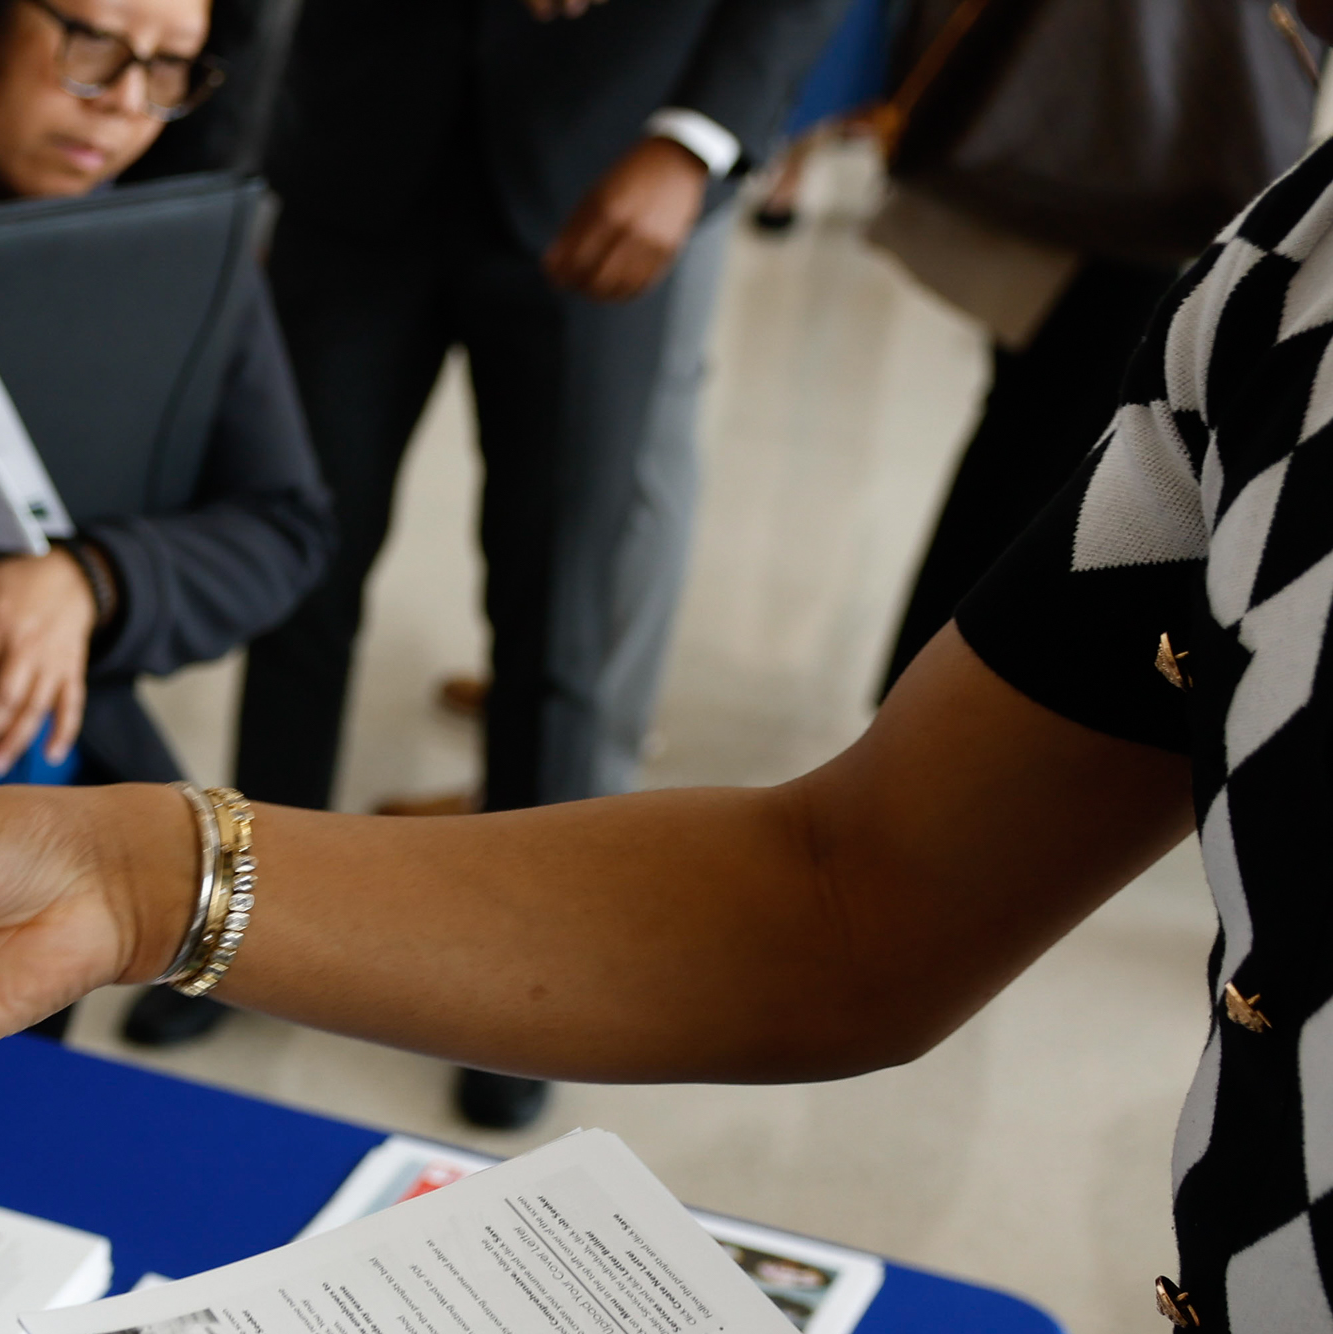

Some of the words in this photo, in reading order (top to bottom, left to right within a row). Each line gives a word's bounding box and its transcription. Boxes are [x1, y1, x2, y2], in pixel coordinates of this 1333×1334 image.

[513, 1195, 539, 1217] screen
[534, 1195, 561, 1218] Seeker
[532, 1216, 550, 1228] the
[555, 1217, 573, 1230] Job
[610, 1213, 632, 1230] Save
[509, 1225, 541, 1252] Letter
[543, 1227, 557, 1236] of
[566, 1229, 586, 1245] click
[625, 1229, 646, 1245] click
[550, 1235, 575, 1256] corner
[582, 1230, 611, 1255] Builder
[639, 1244, 658, 1257] and
[533, 1251, 566, 1280] Cover
[568, 1255, 586, 1268] left
[580, 1244, 619, 1281] Individuals,
[605, 1254, 630, 1275] Letter
[622, 1249, 648, 1271] Letter
[579, 1267, 597, 1280] top
[641, 1270, 662, 1286] New
[651, 1256, 683, 1284] prompts
[558, 1279, 586, 1301] Your
[590, 1279, 608, 1293] the
[612, 1280, 628, 1290] for
[623, 1274, 644, 1290] click
[676, 1283, 694, 1296] the
[621, 1289, 653, 1317] Services
[637, 1289, 656, 1303] and
[656, 1286, 683, 1308] Create
[607, 1298, 632, 1318] Menu
[687, 1295, 714, 1318] Follow
[578, 1301, 616, 1334] Upload
[625, 1318, 641, 1328] on
[650, 1302, 682, 1332] Services
[677, 1308, 698, 1325] Click
